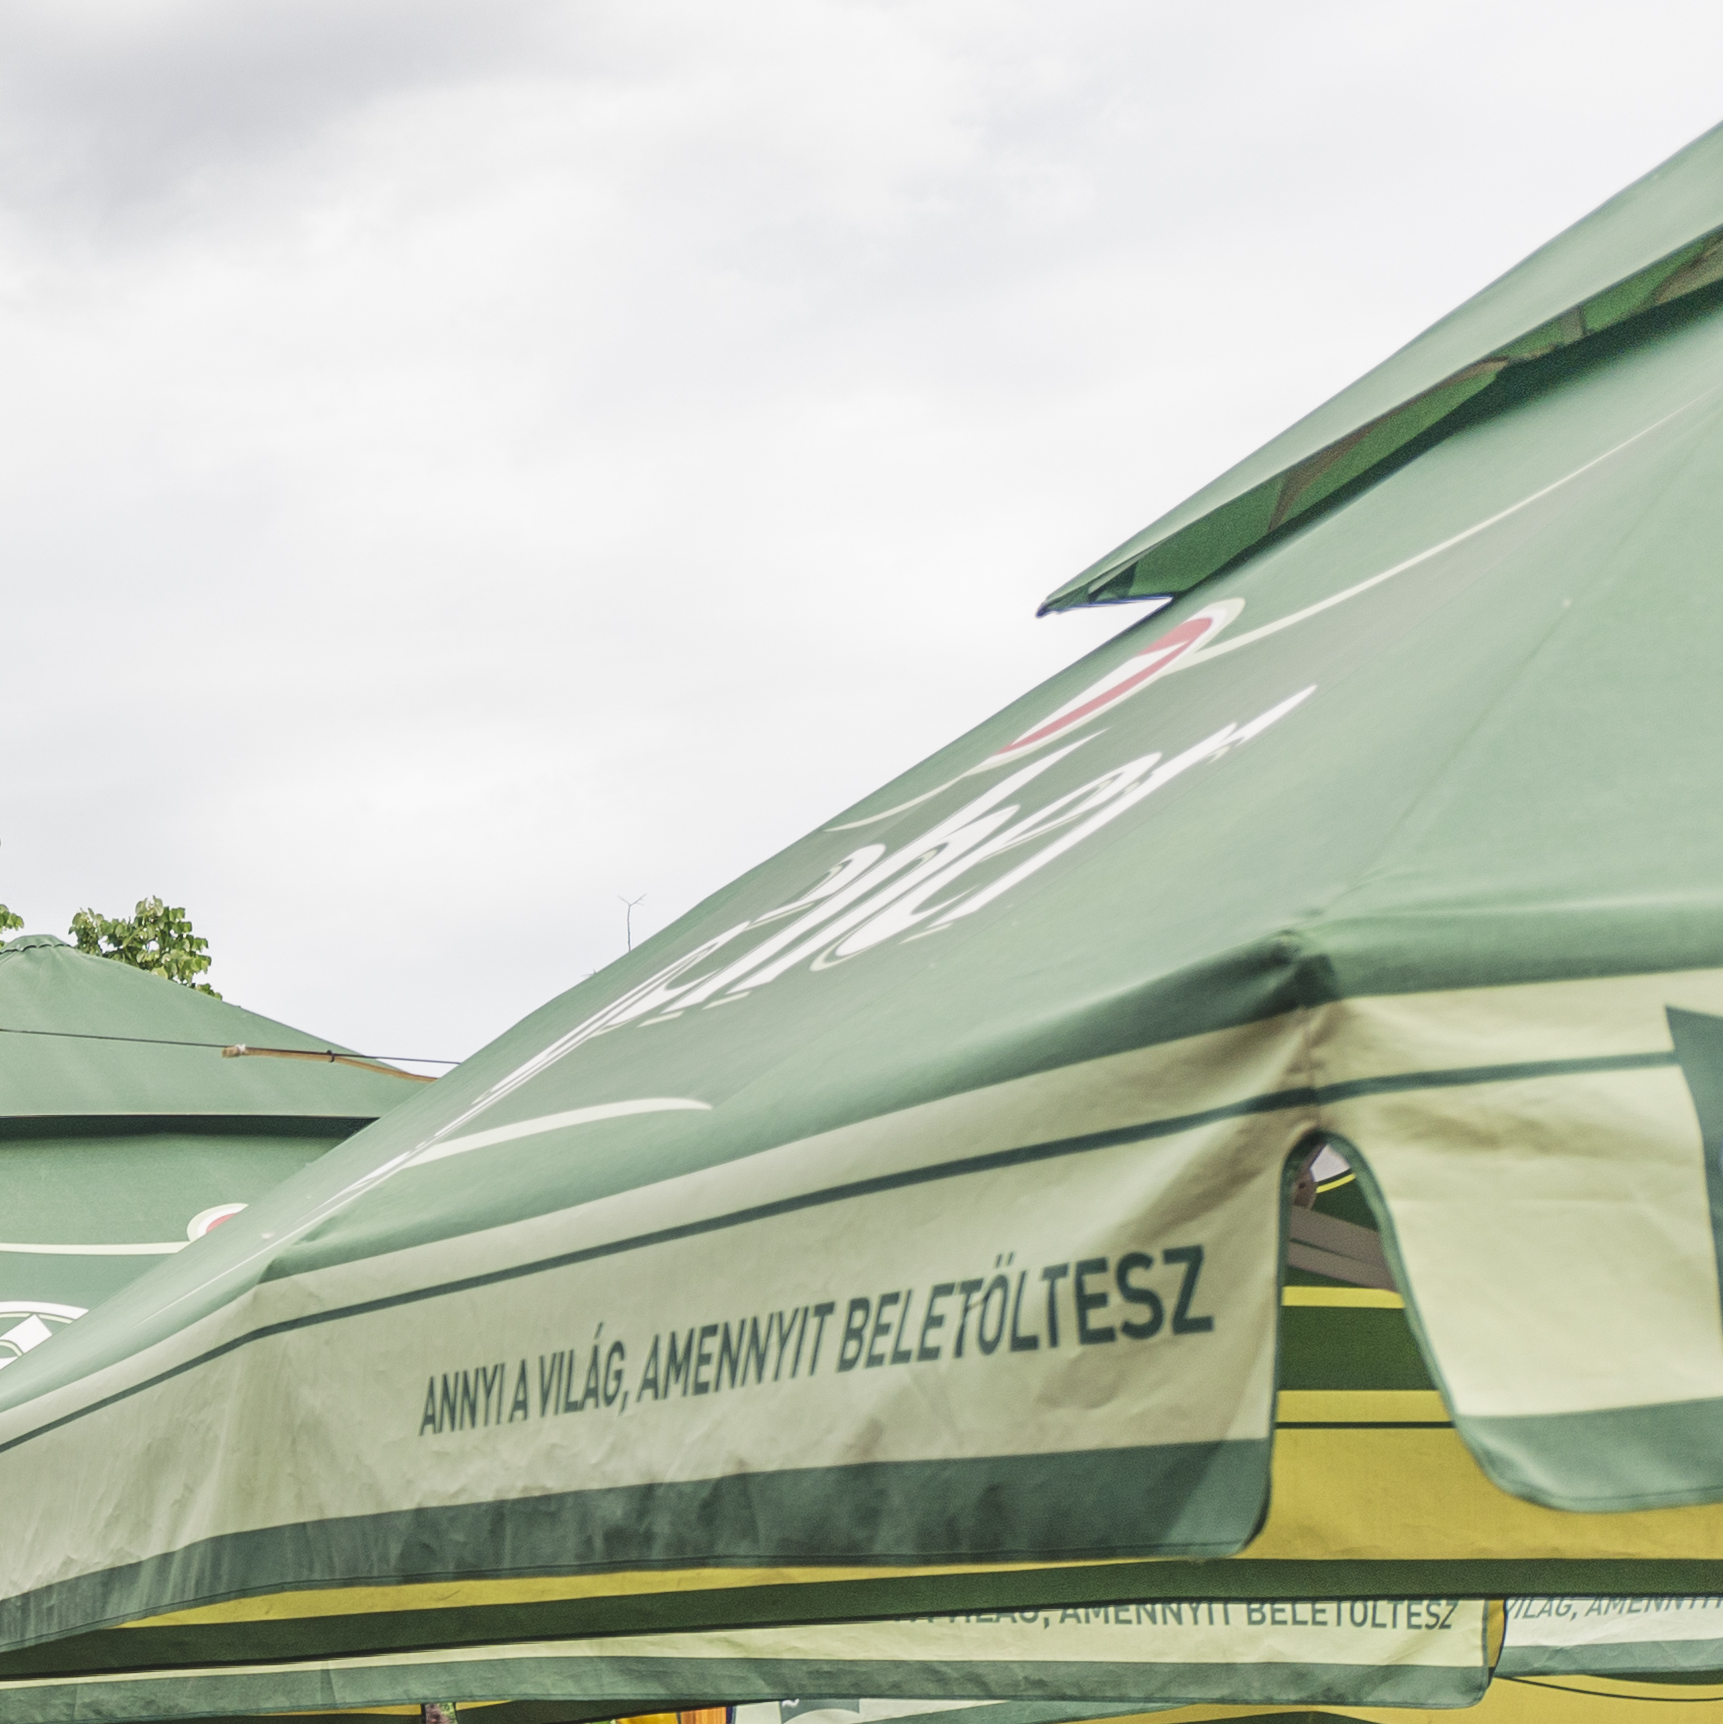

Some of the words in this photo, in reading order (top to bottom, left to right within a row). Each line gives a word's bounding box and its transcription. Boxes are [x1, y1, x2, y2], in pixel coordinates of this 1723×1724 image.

[418, 1363, 506, 1436] ANNYI
[509, 1358, 529, 1423] A
[539, 1321, 629, 1417] VILÁG,
[635, 1301, 836, 1402] AMENNYIT
